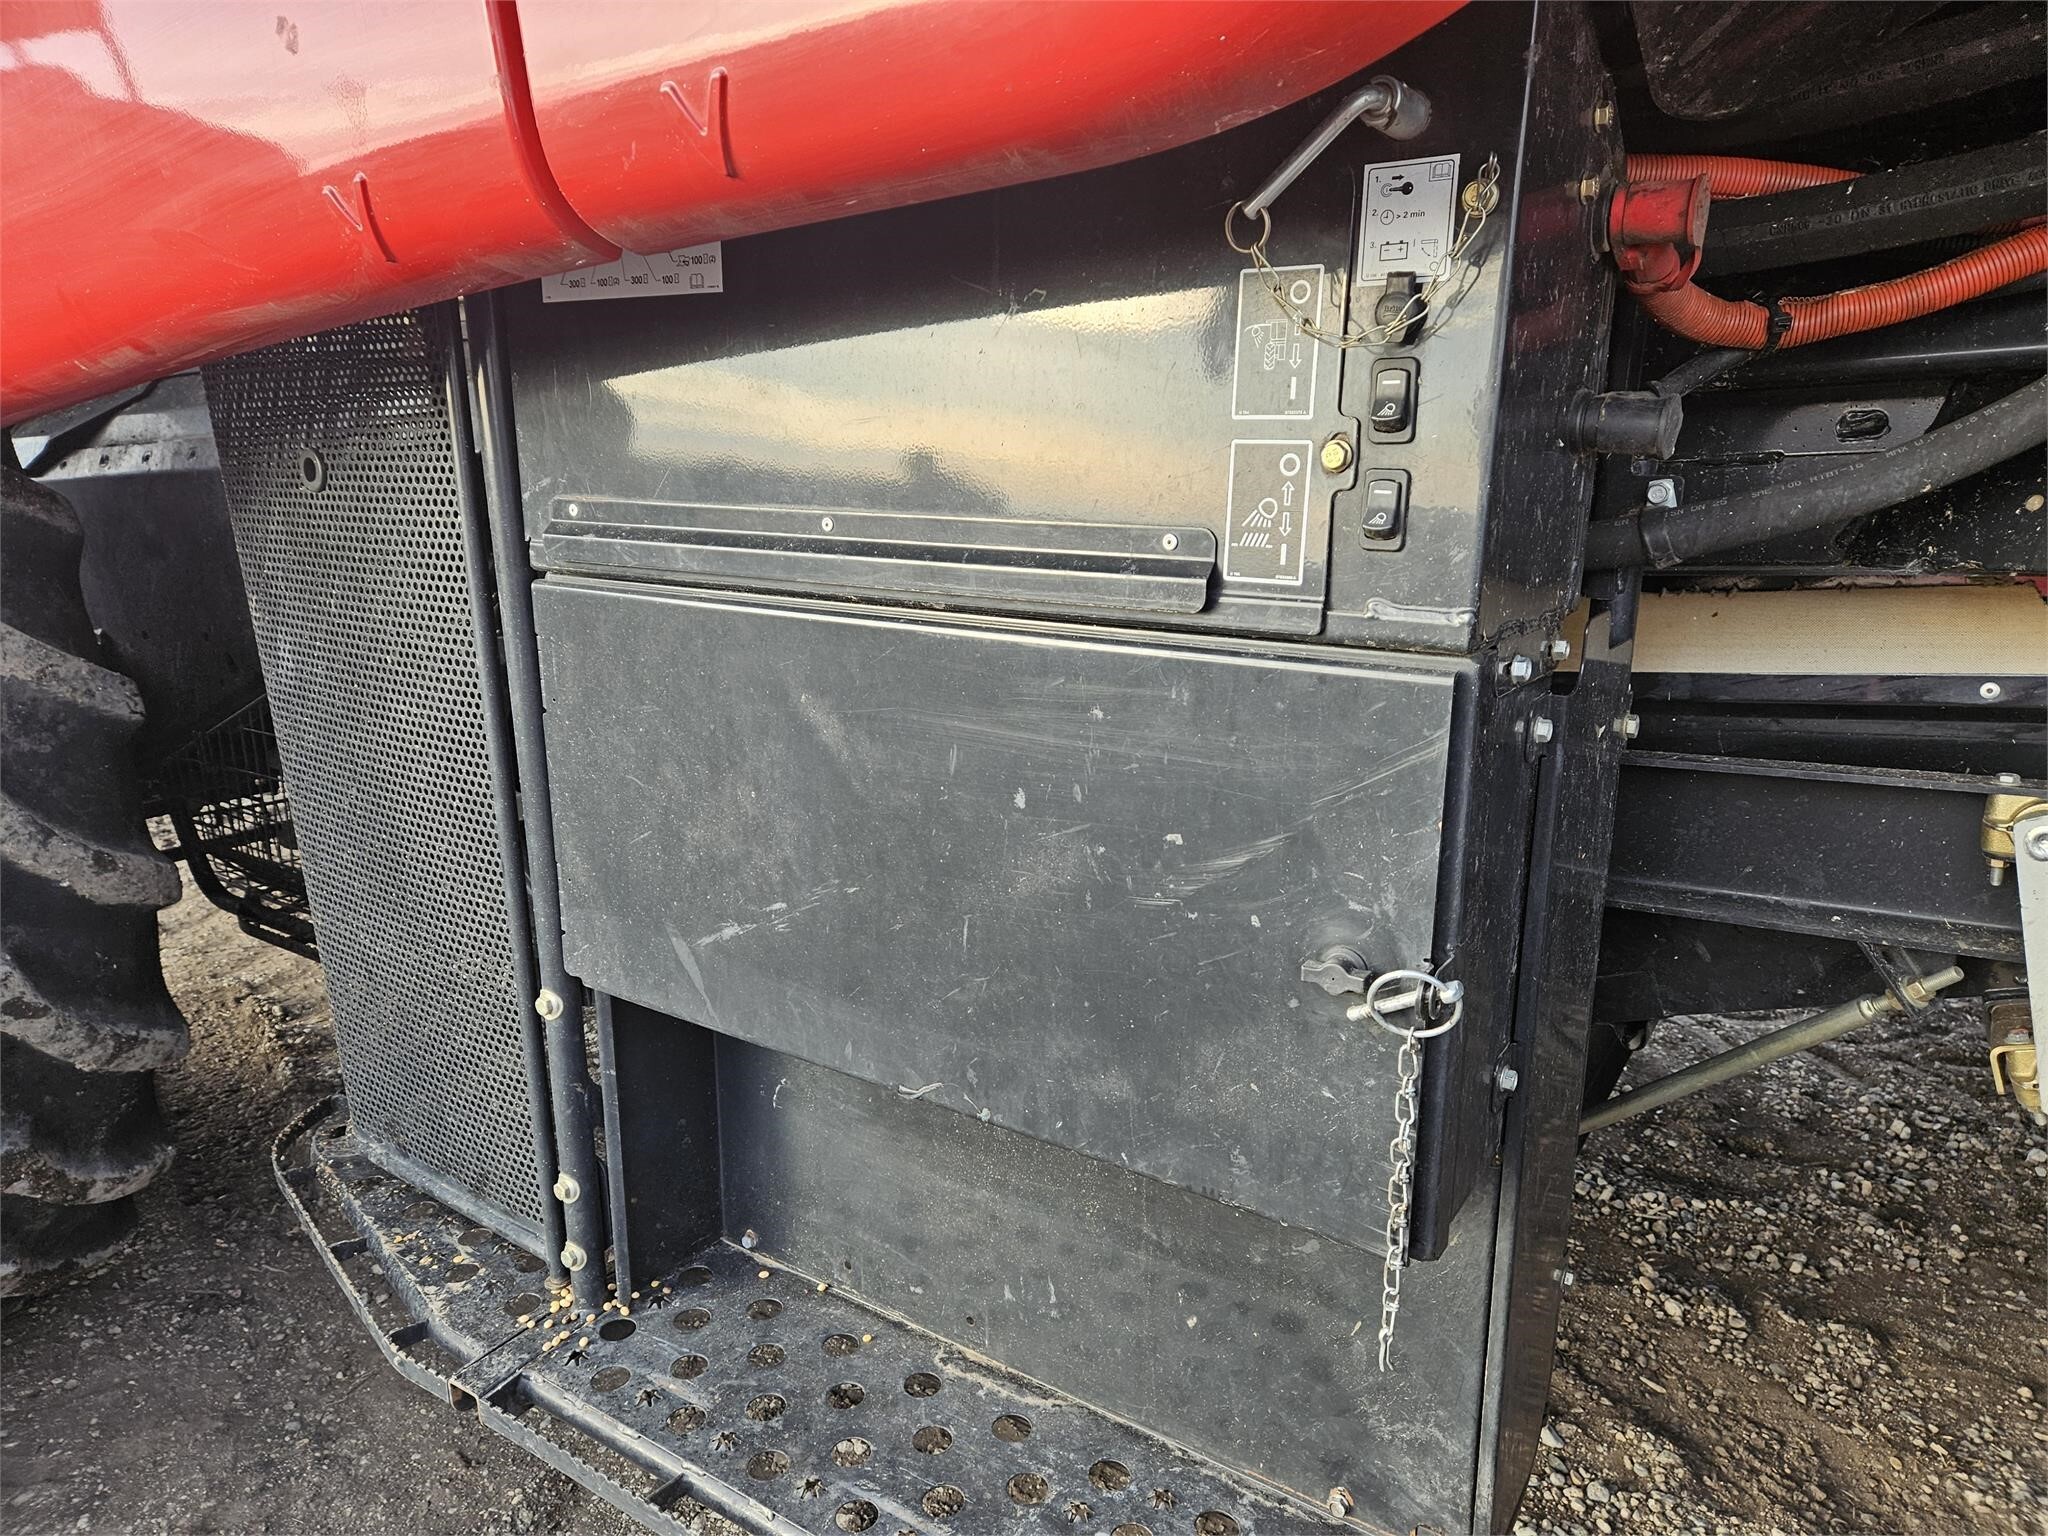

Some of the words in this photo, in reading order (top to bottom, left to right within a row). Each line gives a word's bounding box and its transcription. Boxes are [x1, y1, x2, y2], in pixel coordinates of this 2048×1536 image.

[1371, 209, 1379, 217] 2.
[1403, 210, 1409, 219] 2
[1410, 209, 1426, 218] min
[1370, 241, 1377, 249] 3.
[691, 255, 703, 264] 100
[631, 275, 643, 284] 300
[662, 275, 674, 284] 100
